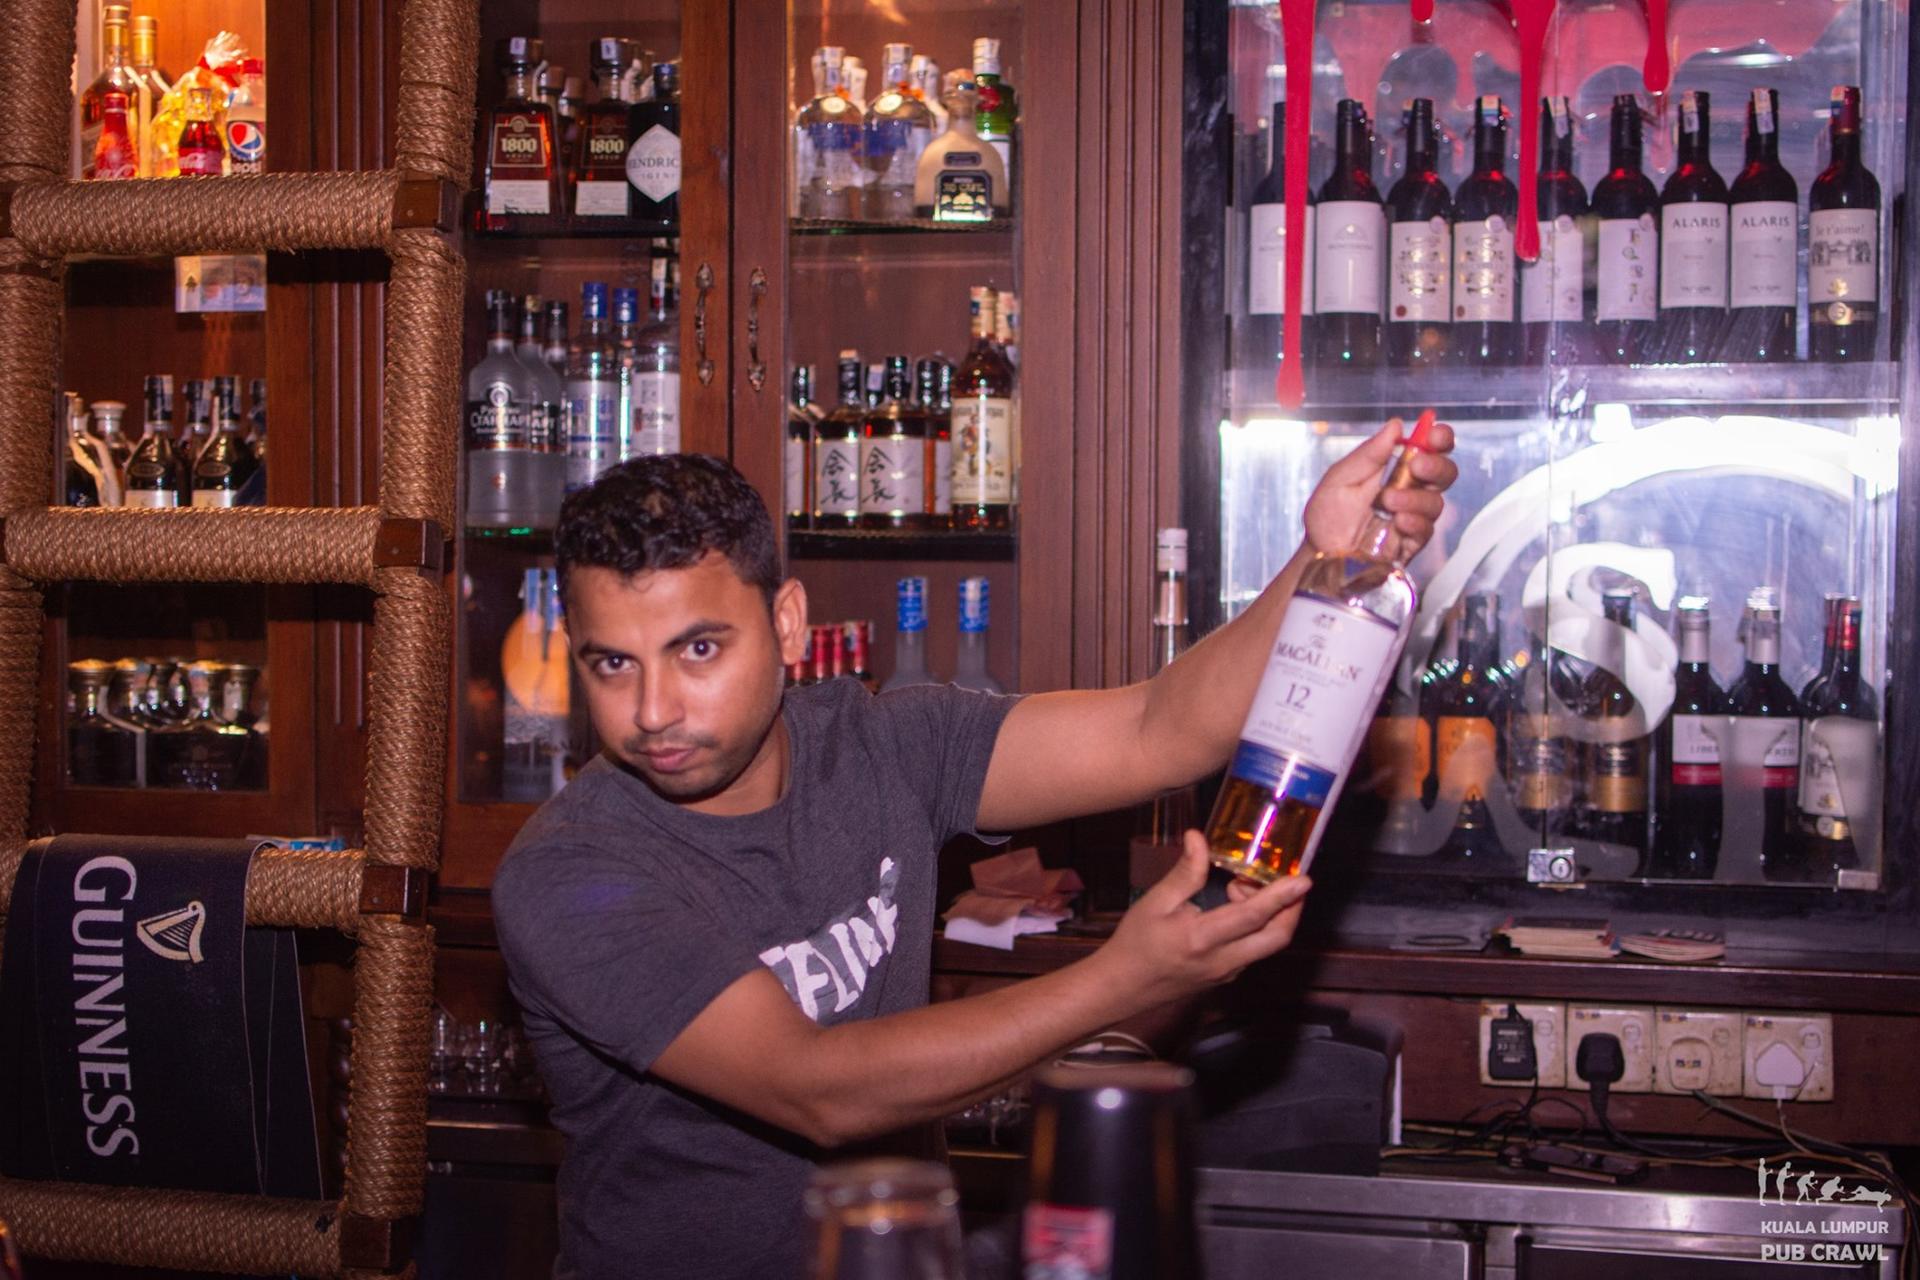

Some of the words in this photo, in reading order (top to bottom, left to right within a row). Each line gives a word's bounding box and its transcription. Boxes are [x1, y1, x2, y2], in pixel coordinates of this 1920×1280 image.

[501, 138, 537, 152] 1800
[590, 139, 624, 153] 1800
[1673, 218, 1720, 228] ALARIS
[1742, 216, 1790, 227] ALARIS
[1285, 683, 1311, 709] 12
[72, 856, 139, 1157] GUINNESS
